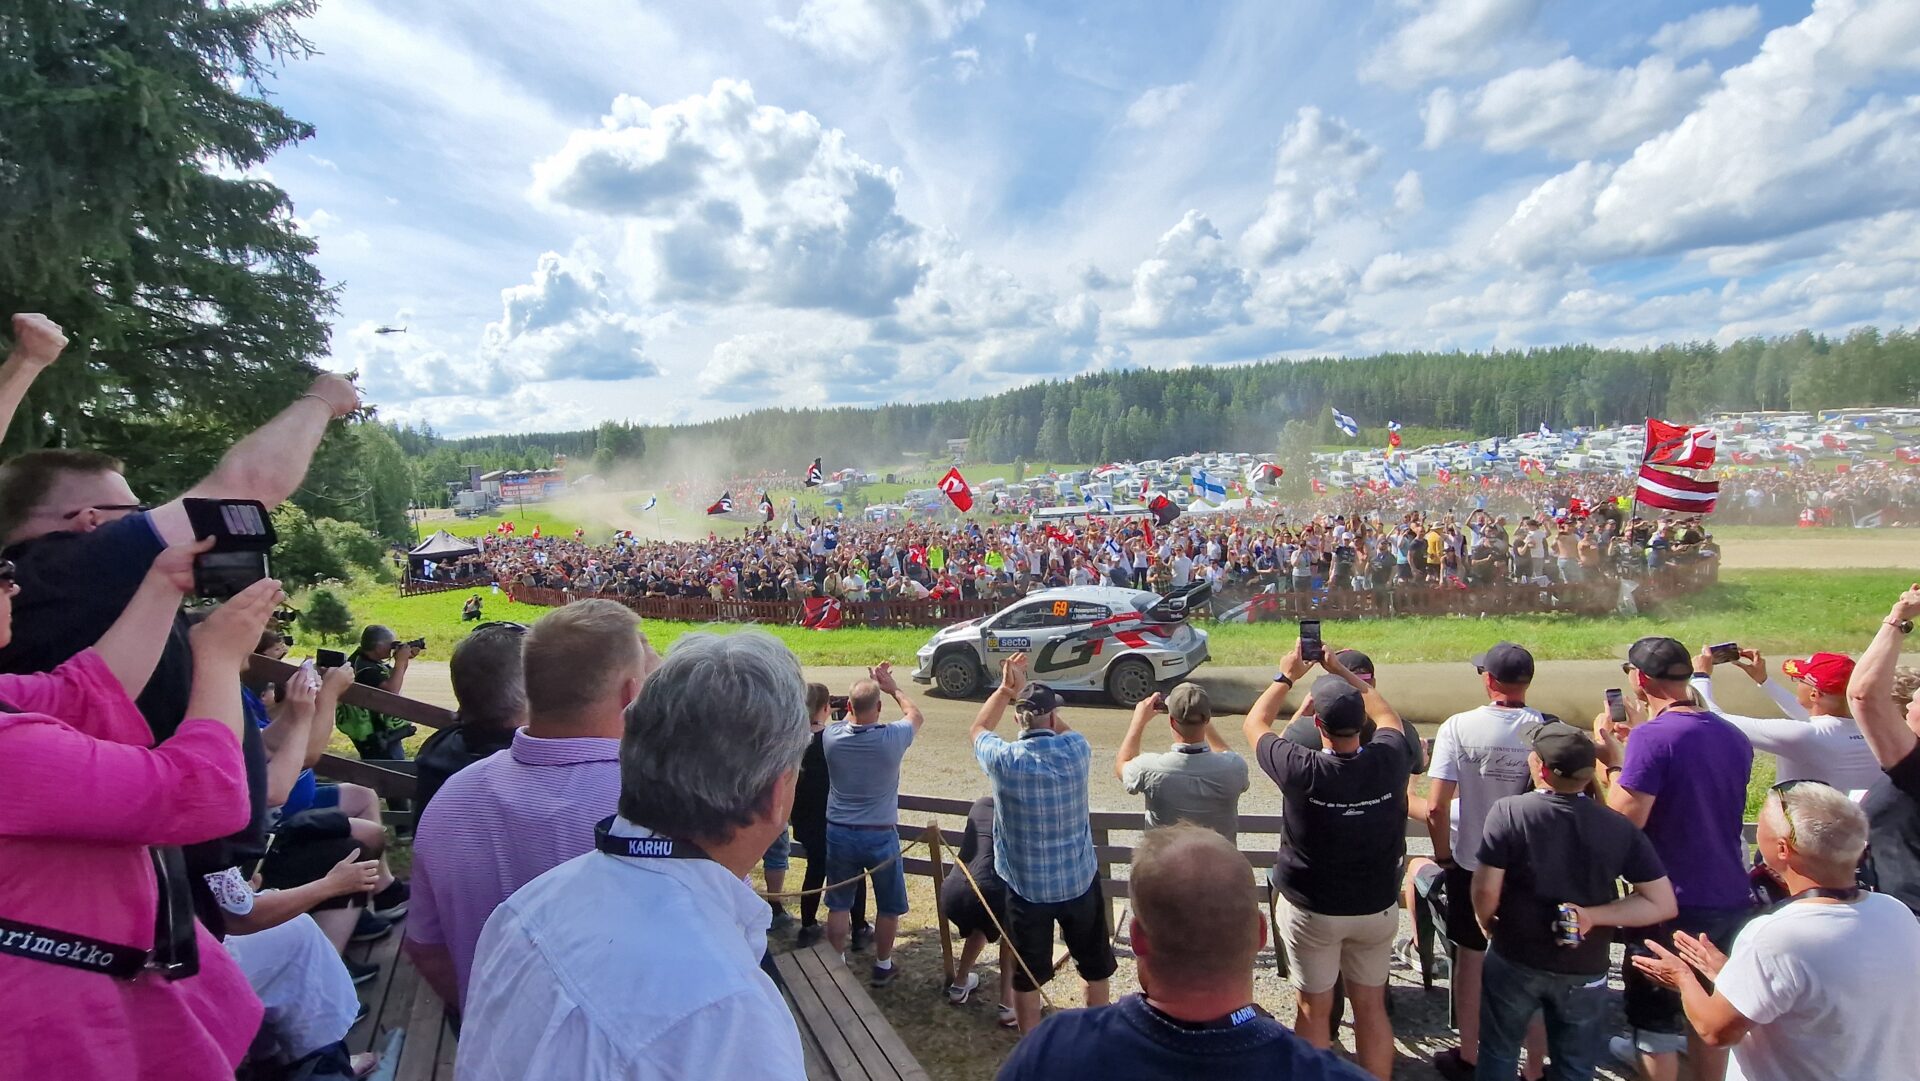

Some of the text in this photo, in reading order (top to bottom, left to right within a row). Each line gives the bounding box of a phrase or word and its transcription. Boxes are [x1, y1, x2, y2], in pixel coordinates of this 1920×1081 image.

[1053, 600, 1069, 616] 69
[1001, 637, 1028, 647] secto
[628, 840, 673, 856] KARHU
[0, 928, 114, 966] rimekko
